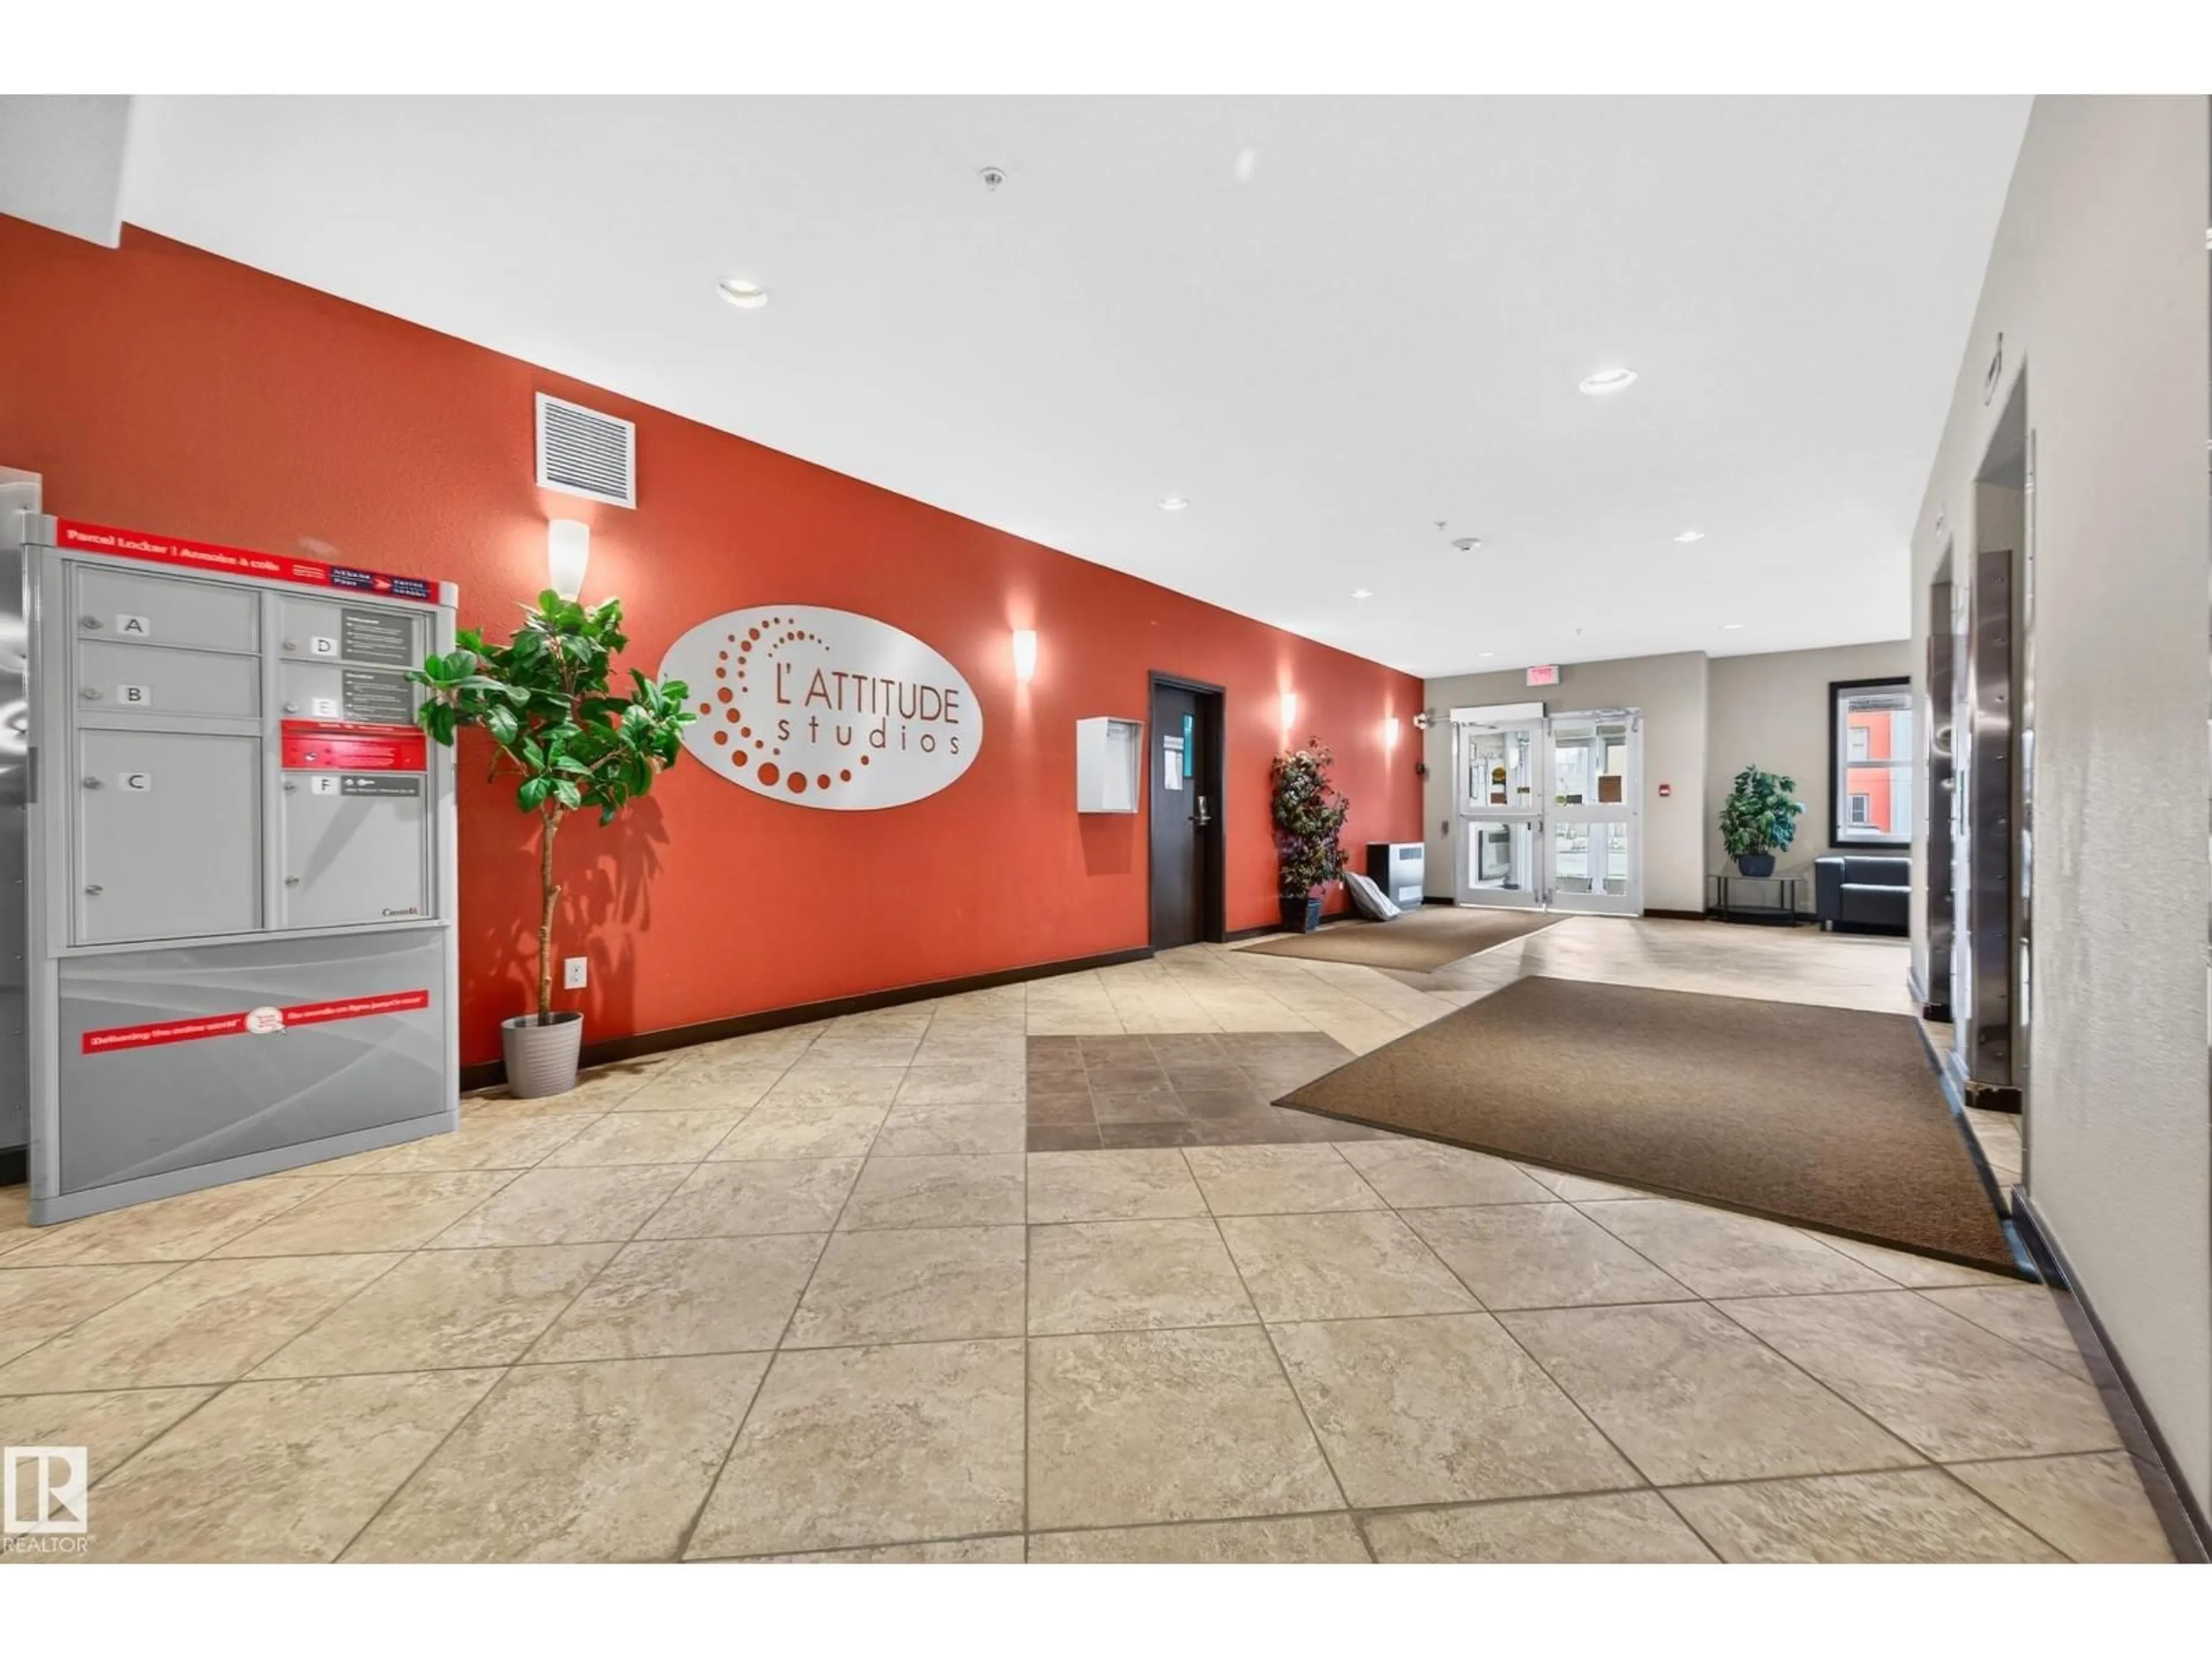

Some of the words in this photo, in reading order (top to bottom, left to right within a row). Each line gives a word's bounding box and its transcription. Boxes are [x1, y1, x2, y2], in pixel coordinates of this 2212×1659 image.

[66, 528, 115, 546] Parcel
[117, 537, 167, 554] Locker
[124, 619, 143, 633] A
[317, 639, 331, 652] D
[127, 687, 142, 702] B
[320, 701, 331, 714] E
[777, 715, 960, 755] studios
[128, 774, 145, 789] C
[321, 779, 331, 791] F
